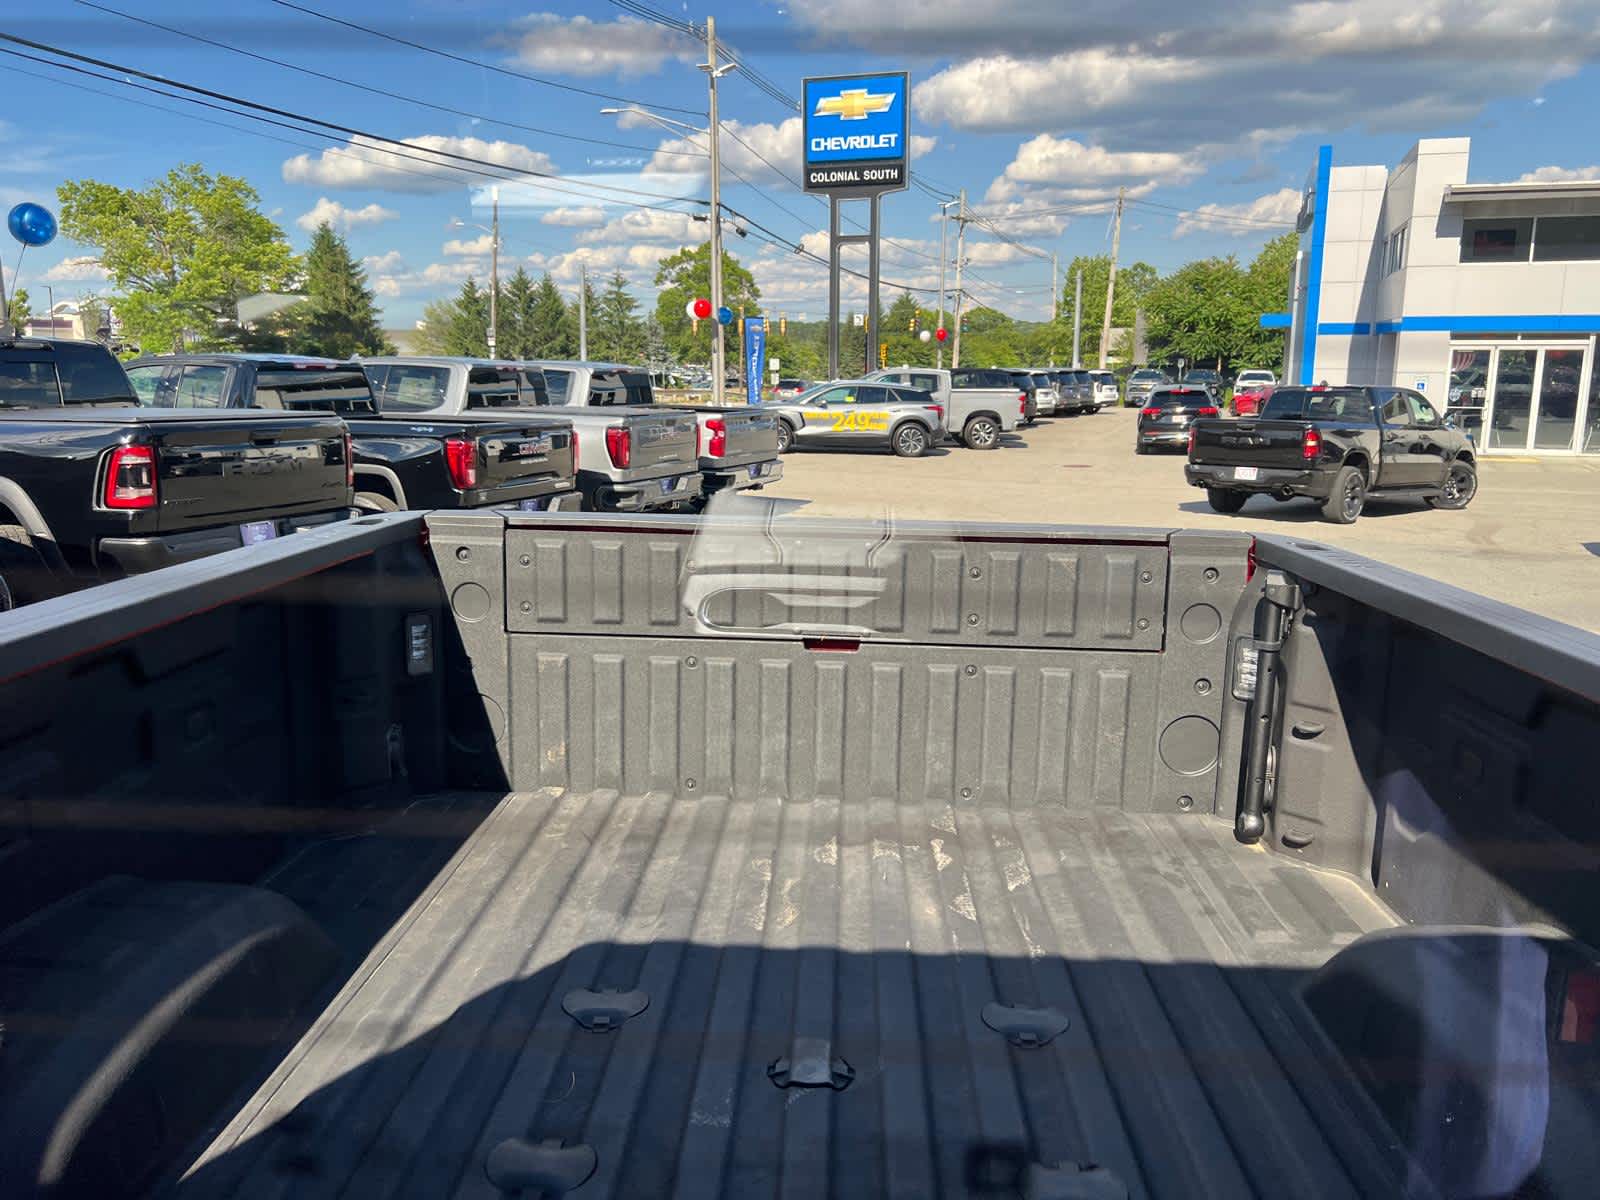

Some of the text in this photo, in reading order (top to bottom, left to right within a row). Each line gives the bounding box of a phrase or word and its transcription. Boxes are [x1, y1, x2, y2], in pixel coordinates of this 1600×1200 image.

[811, 133, 898, 152] CHEVROLET
[810, 168, 898, 183] COLONIAL SOUTH
[832, 411, 871, 432] 249
